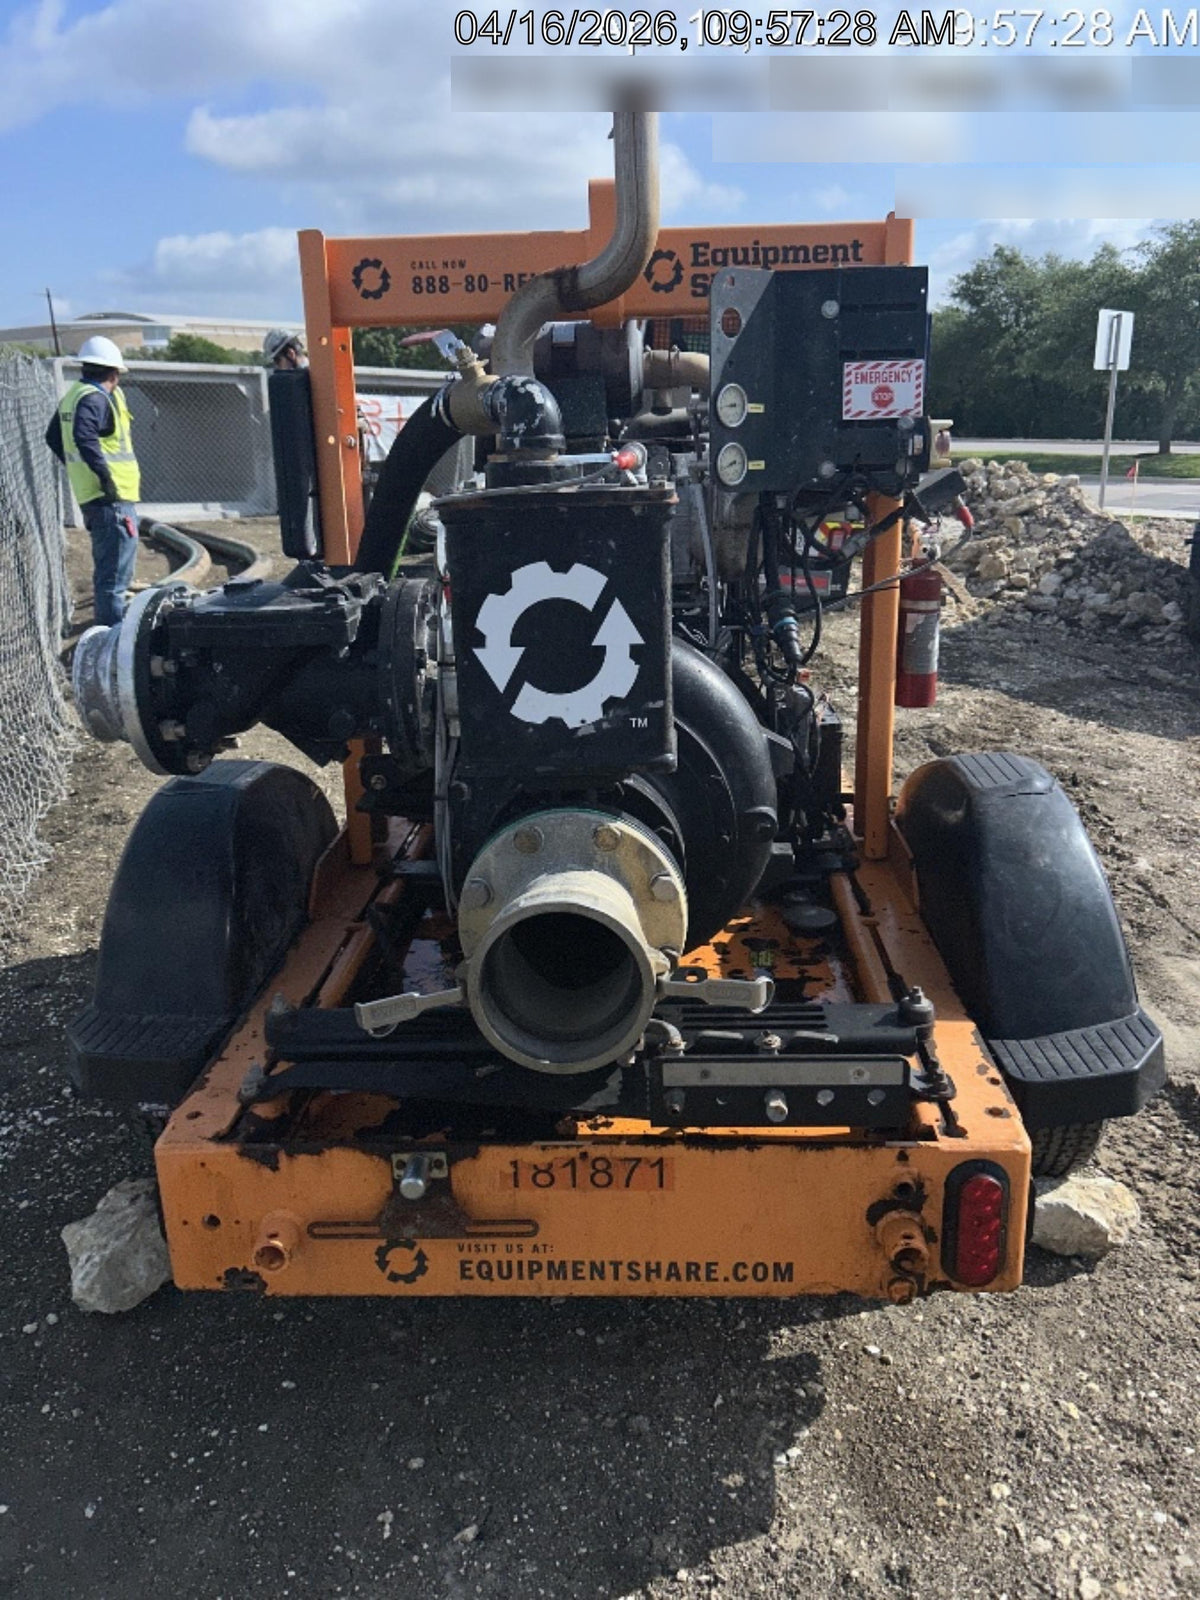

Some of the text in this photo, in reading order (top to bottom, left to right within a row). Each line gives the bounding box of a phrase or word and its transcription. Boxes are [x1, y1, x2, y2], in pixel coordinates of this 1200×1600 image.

[690, 240, 864, 270] Equipment
[410, 259, 467, 270] CALL NOW
[412, 273, 536, 294] 888-80-RE
[854, 370, 913, 384] EMERGENCY
[629, 717, 648, 728] TM
[509, 1156, 665, 1188] 181871
[458, 1243, 554, 1254] VISIT US AT:
[459, 1259, 795, 1282] EQUIPMENTSHARE.COM
